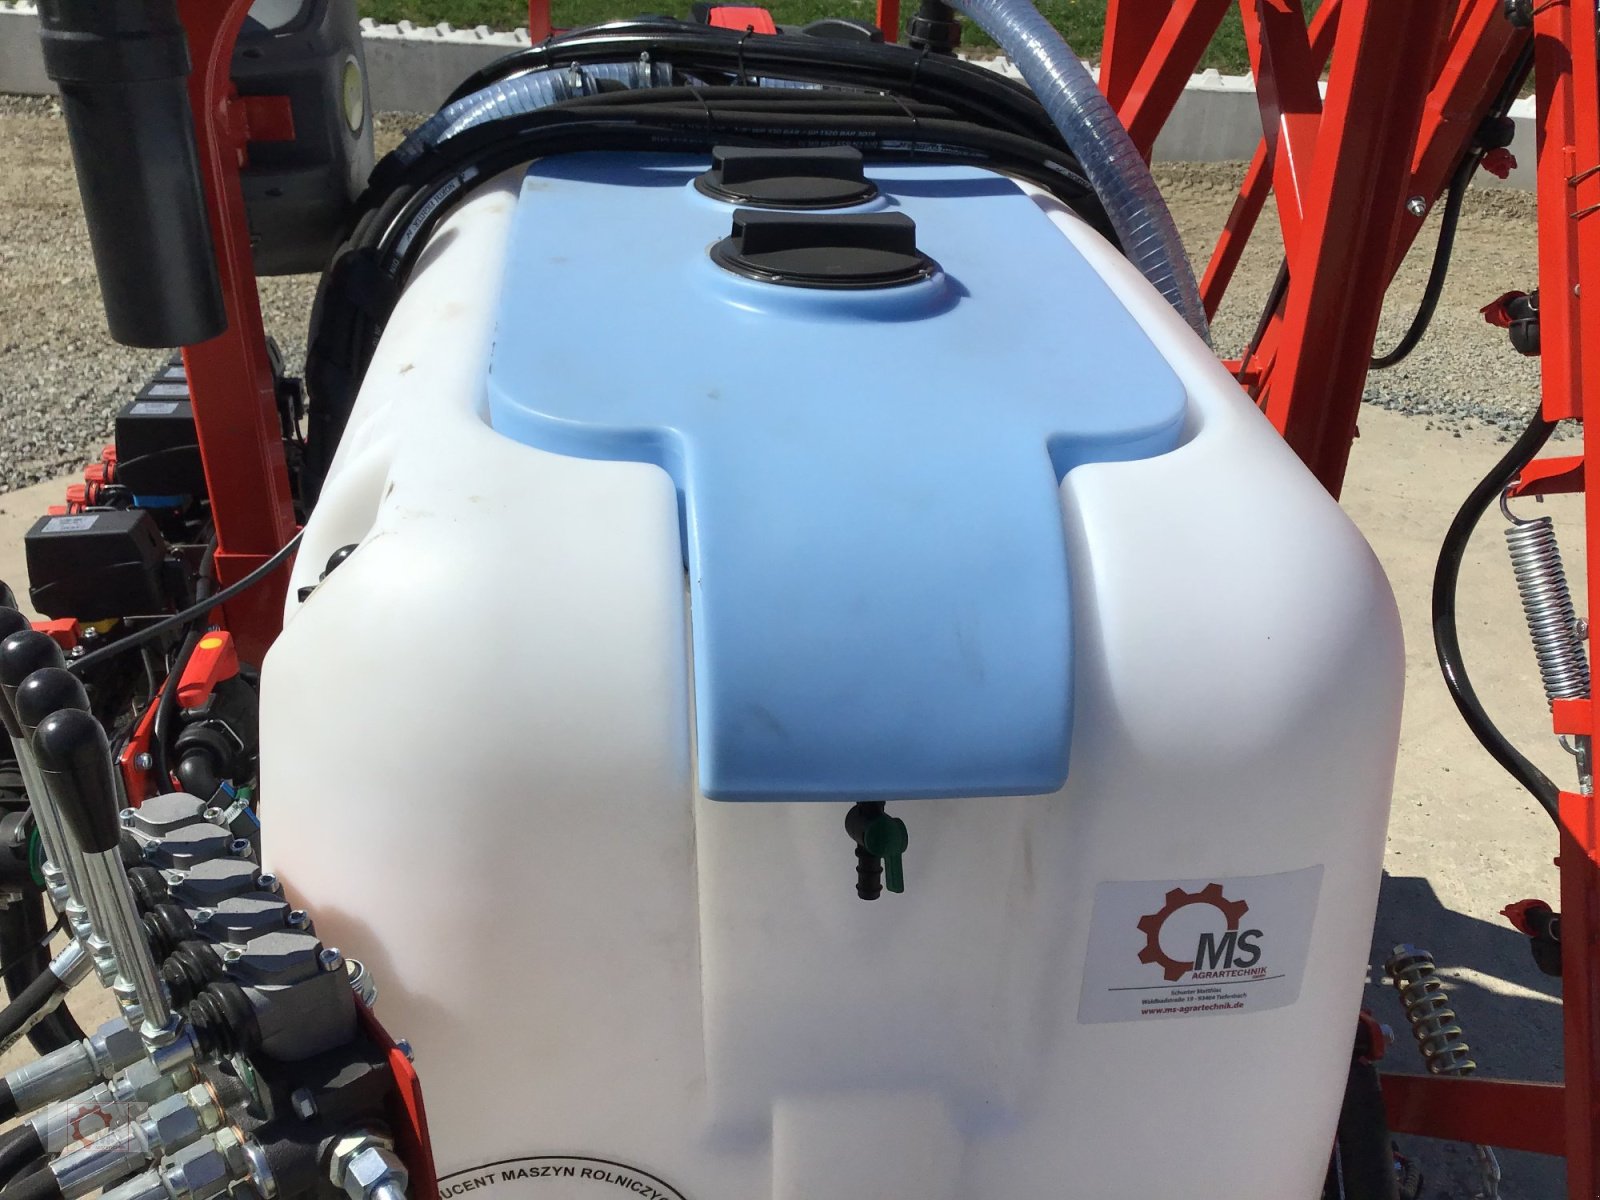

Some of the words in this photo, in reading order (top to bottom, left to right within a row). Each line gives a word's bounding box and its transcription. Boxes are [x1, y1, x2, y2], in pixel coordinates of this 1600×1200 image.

[1194, 929, 1264, 971] MS
[1192, 967, 1268, 980] AGRARTECHNIK
[1141, 1001, 1244, 1016] www.ms-agrartechnik.de
[439, 1173, 495, 1200] UCENT
[501, 1165, 575, 1182] MASZYN
